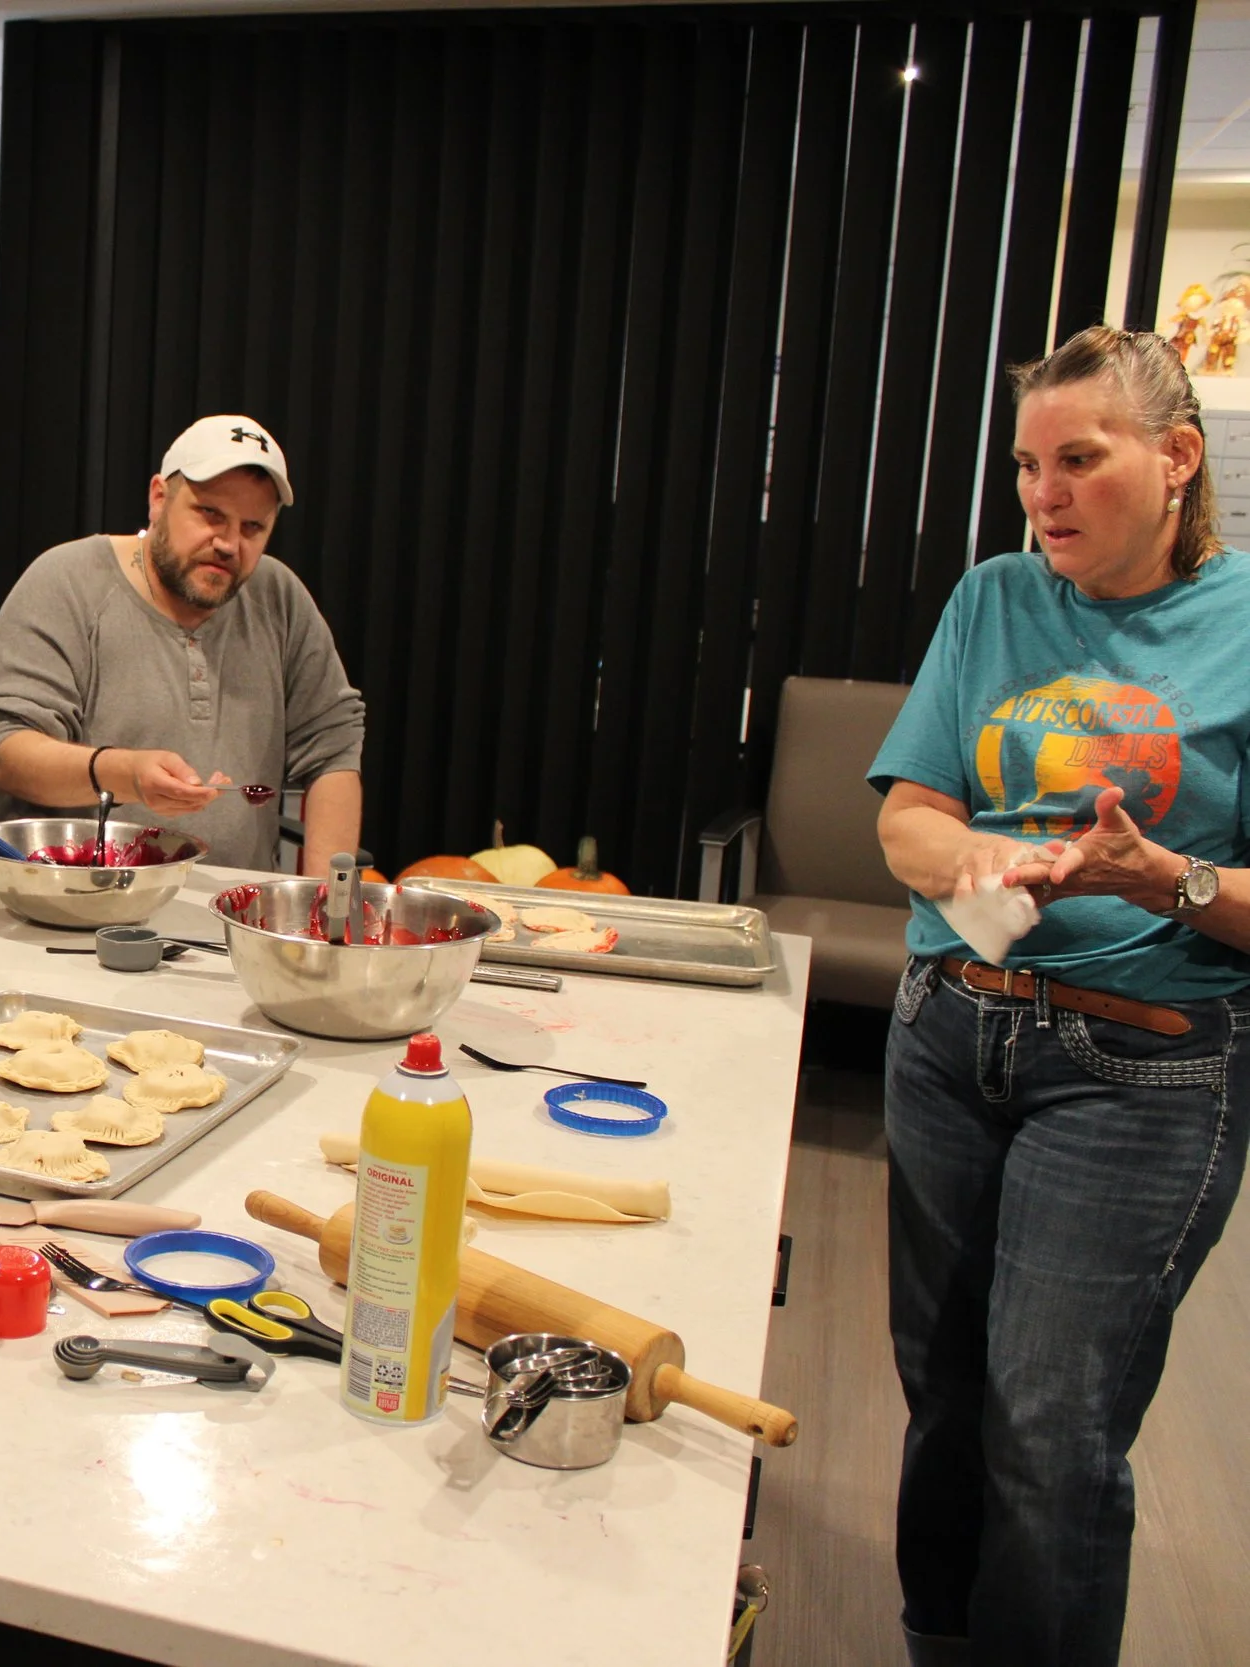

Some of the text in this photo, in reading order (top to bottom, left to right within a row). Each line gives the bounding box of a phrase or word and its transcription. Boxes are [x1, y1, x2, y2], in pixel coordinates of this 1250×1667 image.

[1011, 695, 1159, 731] WISCONSIN
[1064, 733, 1170, 769] DELLS
[367, 1167, 415, 1188] ORIGINAL
